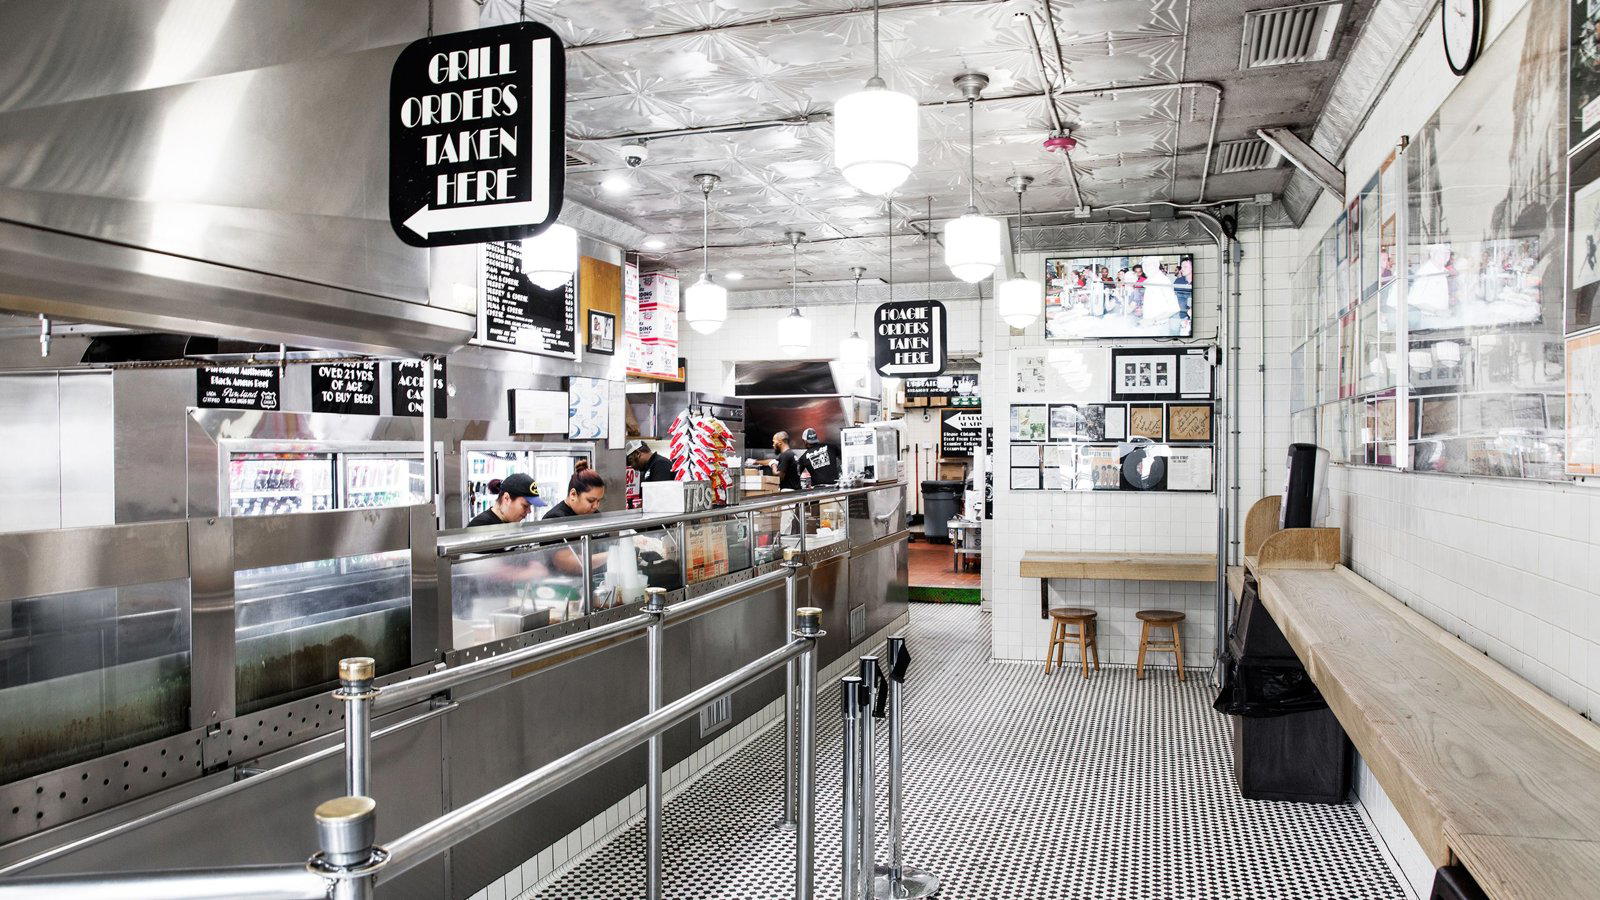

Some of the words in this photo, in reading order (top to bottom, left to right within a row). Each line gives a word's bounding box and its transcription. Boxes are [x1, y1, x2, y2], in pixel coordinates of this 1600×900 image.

[428, 43, 517, 85] GRILL
[401, 84, 518, 128] ORDERS
[421, 126, 518, 166] TAKEN
[436, 167, 517, 206] HERE
[880, 306, 929, 321] HOAGIE
[878, 321, 930, 336] ORDERS
[888, 336, 930, 350] TAKEN
[894, 351, 930, 365] HERE
[210, 375, 232, 386] Black
[318, 366, 343, 379] OVER
[344, 369, 355, 380] 21
[356, 370, 374, 381] YRS.
[331, 379, 344, 391] OF
[346, 380, 363, 392] AGE
[398, 375, 444, 389] ACCETS
[322, 390, 334, 402] TO
[336, 391, 352, 403] BUY
[354, 393, 374, 404] BEER
[406, 388, 425, 400] CAS
